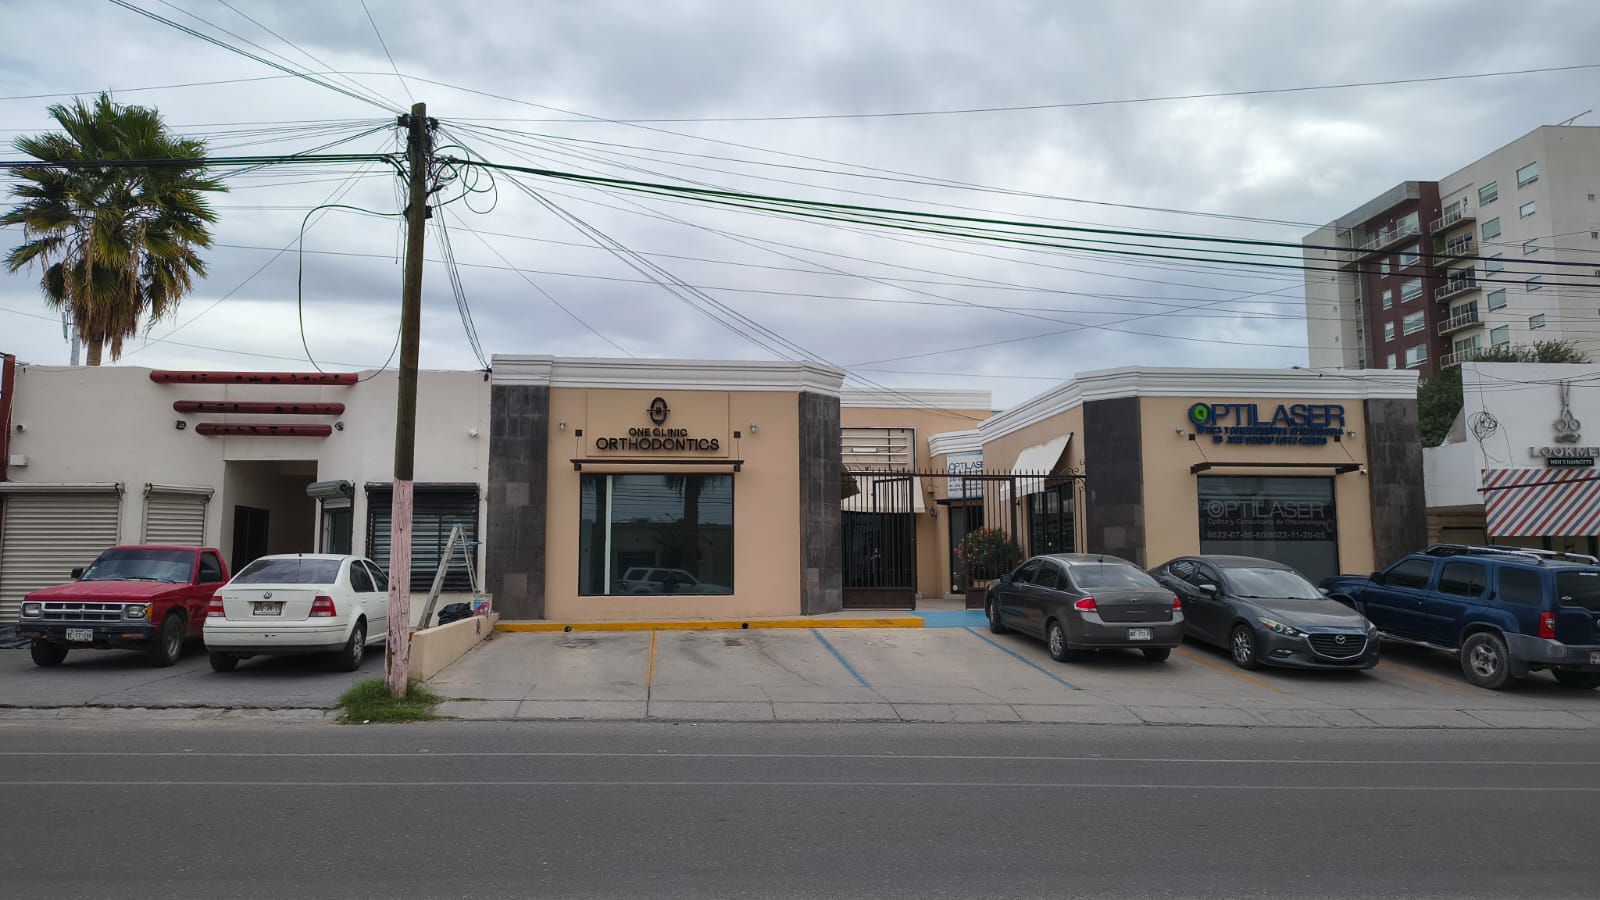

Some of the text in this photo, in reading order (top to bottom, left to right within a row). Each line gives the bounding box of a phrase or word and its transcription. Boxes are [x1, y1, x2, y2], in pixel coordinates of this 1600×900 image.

[1188, 402, 1345, 427] OPTILASER
[628, 428, 688, 437] ONE CLINIC
[596, 438, 720, 451] ORTHODONTICS
[1207, 500, 1326, 519] OPTILASER
